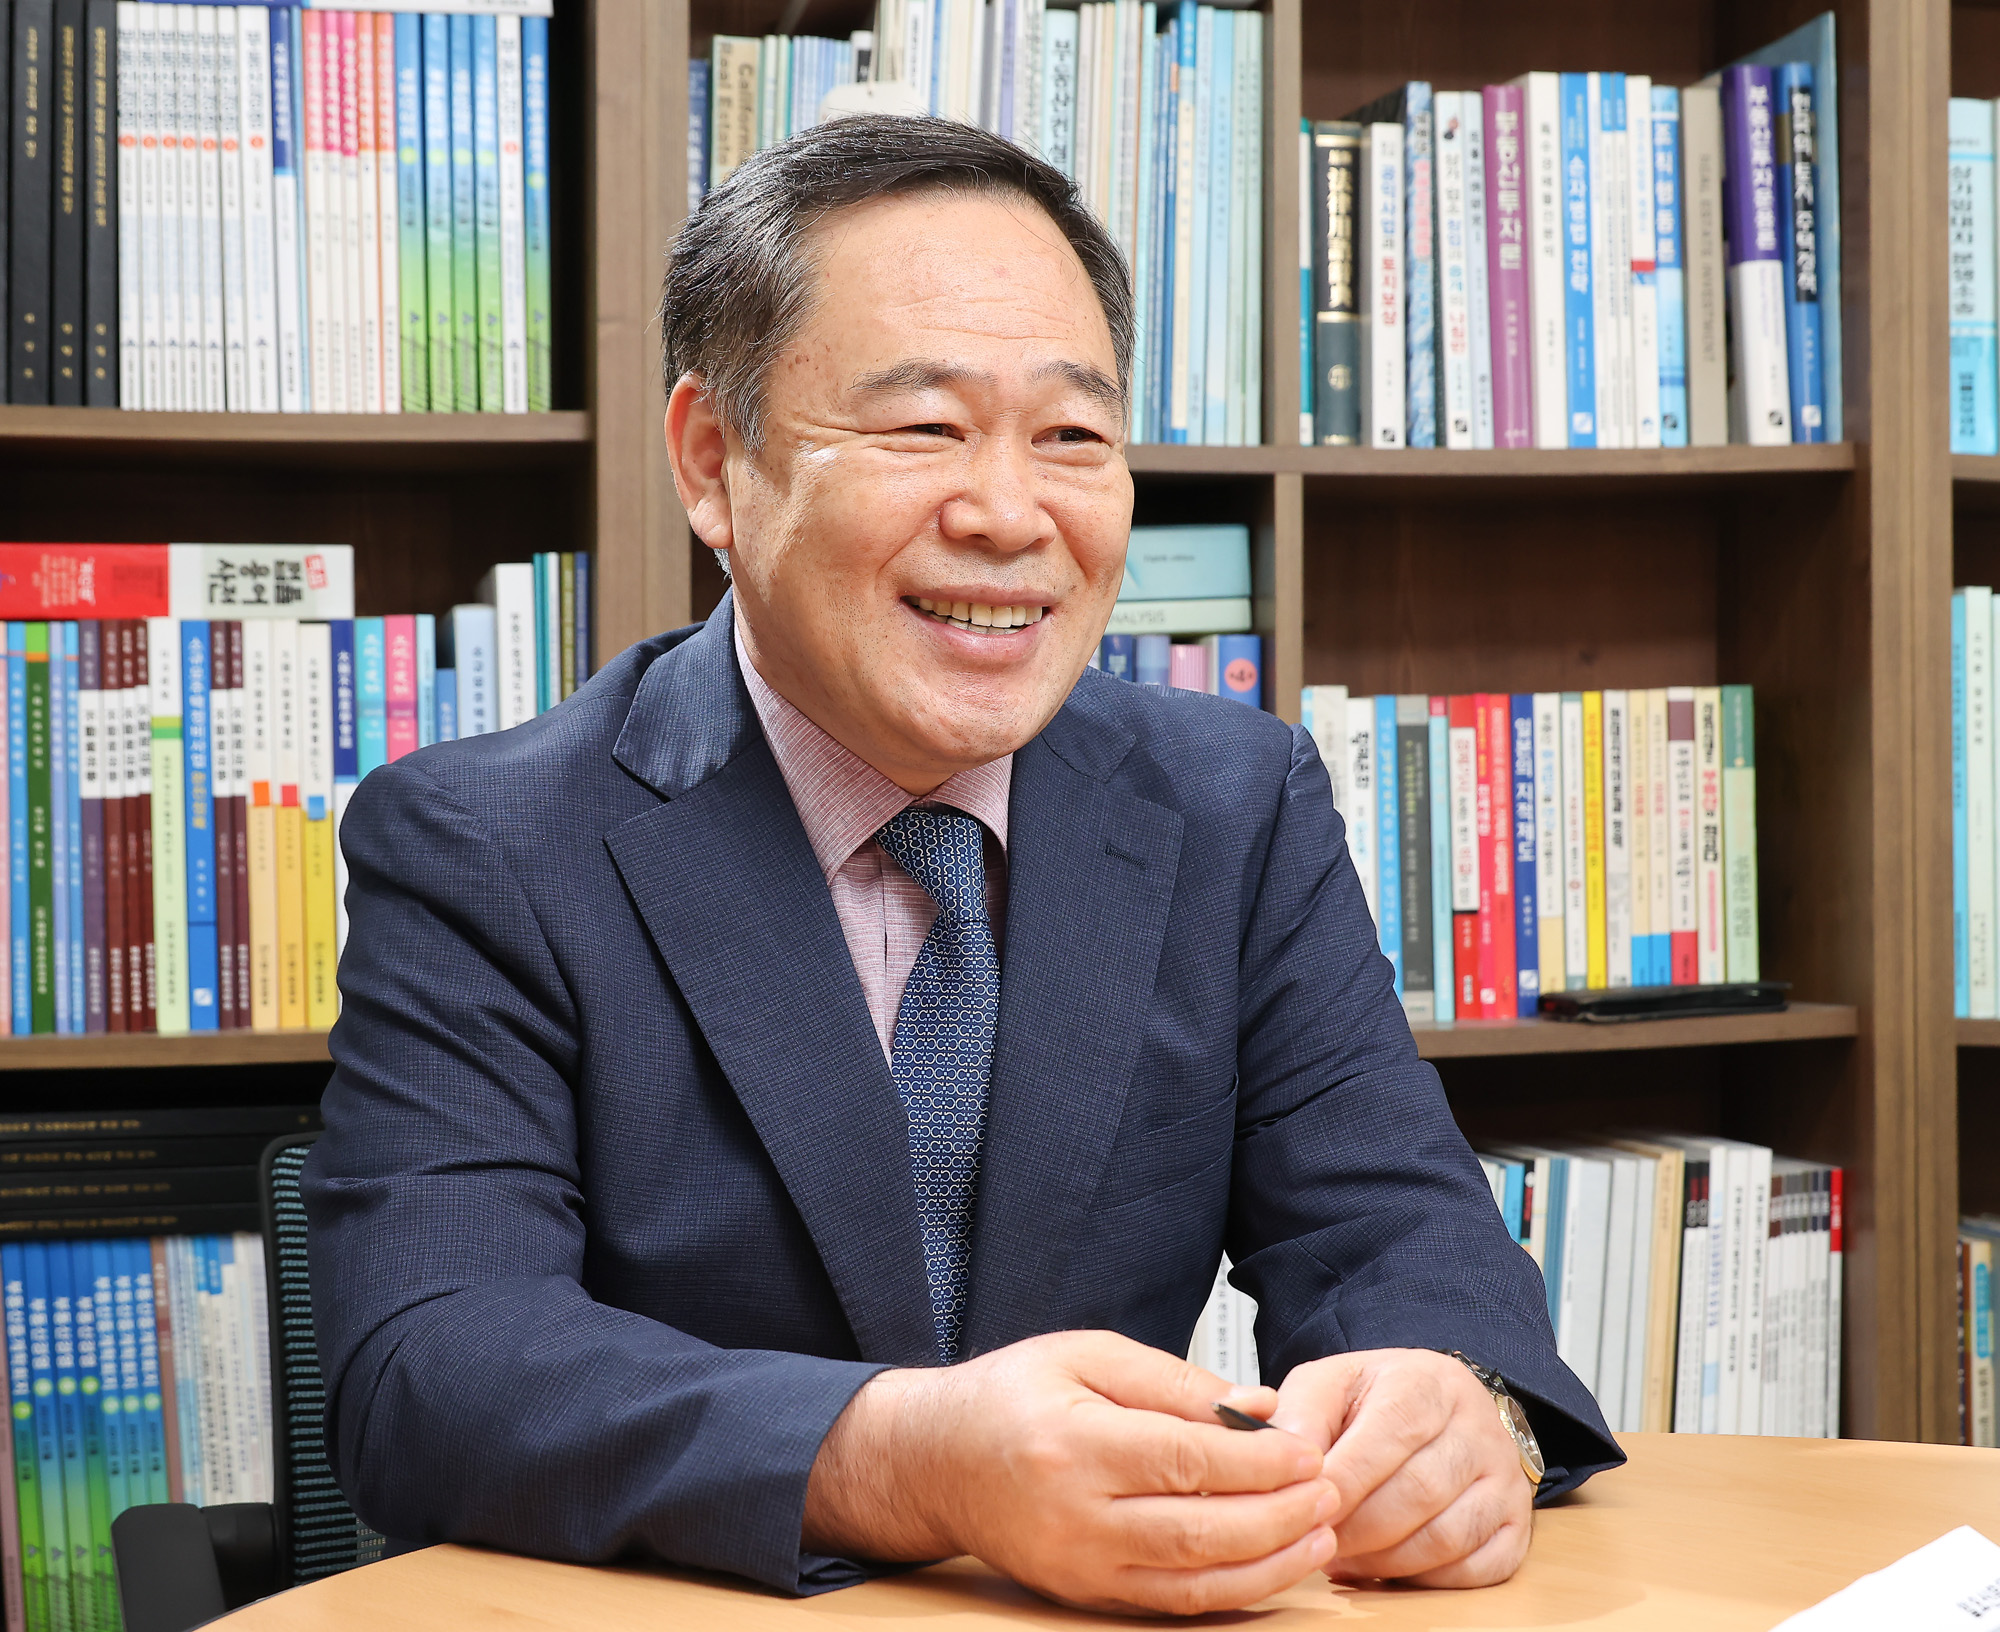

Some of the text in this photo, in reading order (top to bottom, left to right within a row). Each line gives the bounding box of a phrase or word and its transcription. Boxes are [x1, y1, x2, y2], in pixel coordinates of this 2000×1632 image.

[1495, 110, 1523, 271] 부동산투자론
[1653, 121, 1677, 265] 조직행동론
[207, 558, 236, 605] 사전
[239, 559, 270, 606] 용어
[273, 559, 305, 605] 법률
[1514, 716, 1536, 863] 일본의 지적제도
